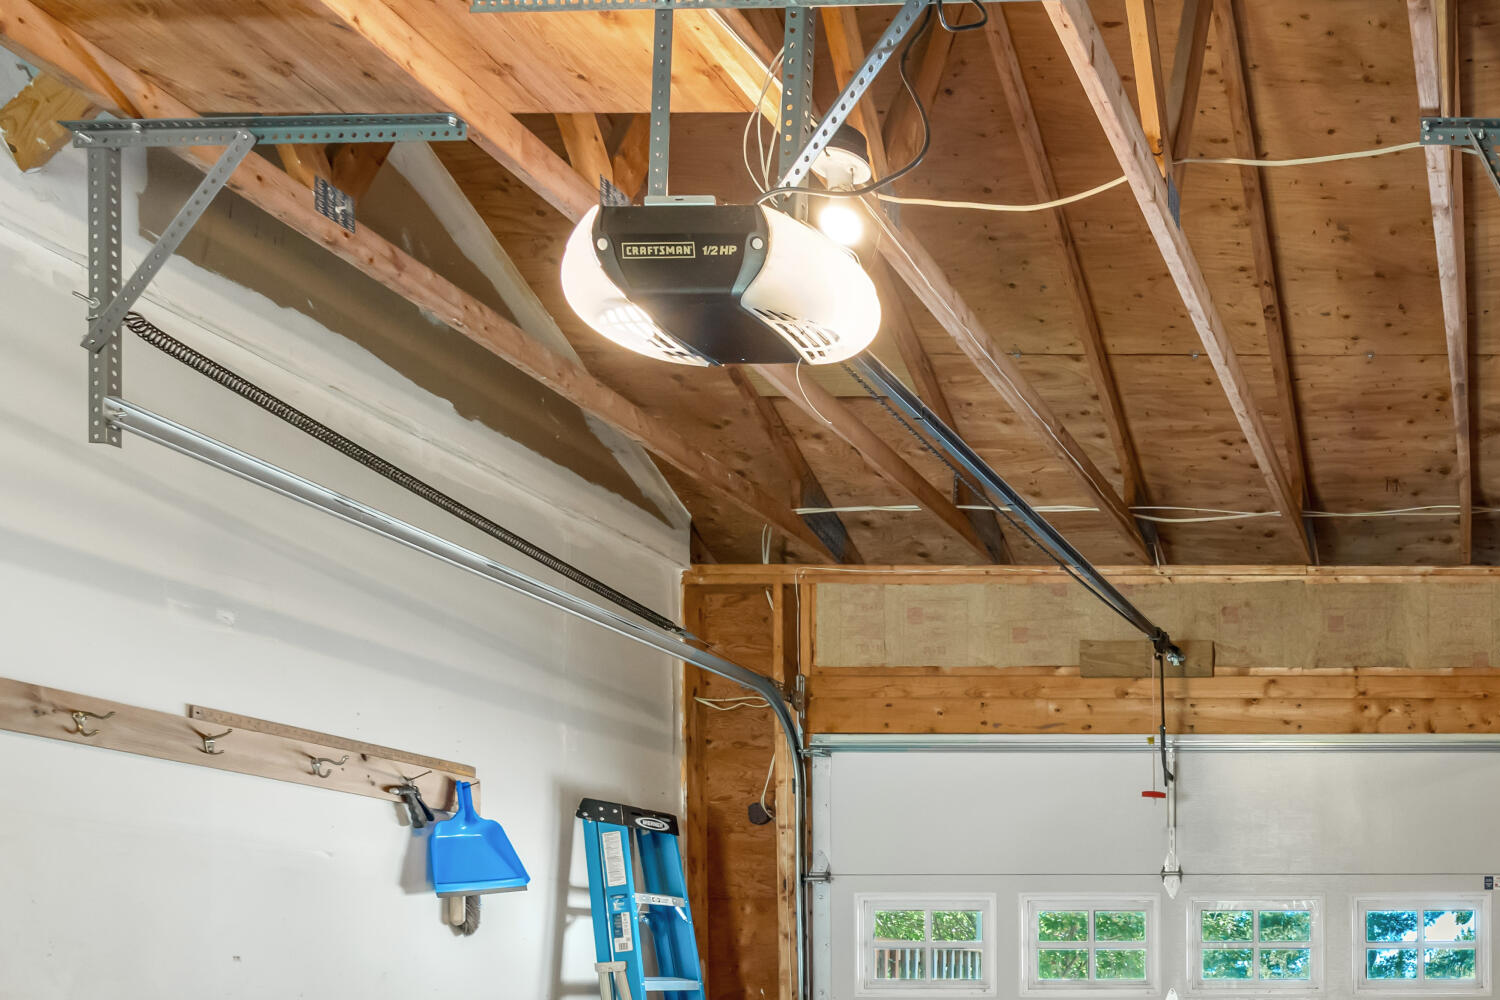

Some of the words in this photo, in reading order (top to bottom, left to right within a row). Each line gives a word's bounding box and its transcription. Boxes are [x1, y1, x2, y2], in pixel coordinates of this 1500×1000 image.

[626, 246, 693, 256] CRAFTSMAN
[702, 246, 718, 256] 1/2
[719, 245, 737, 256] HP
